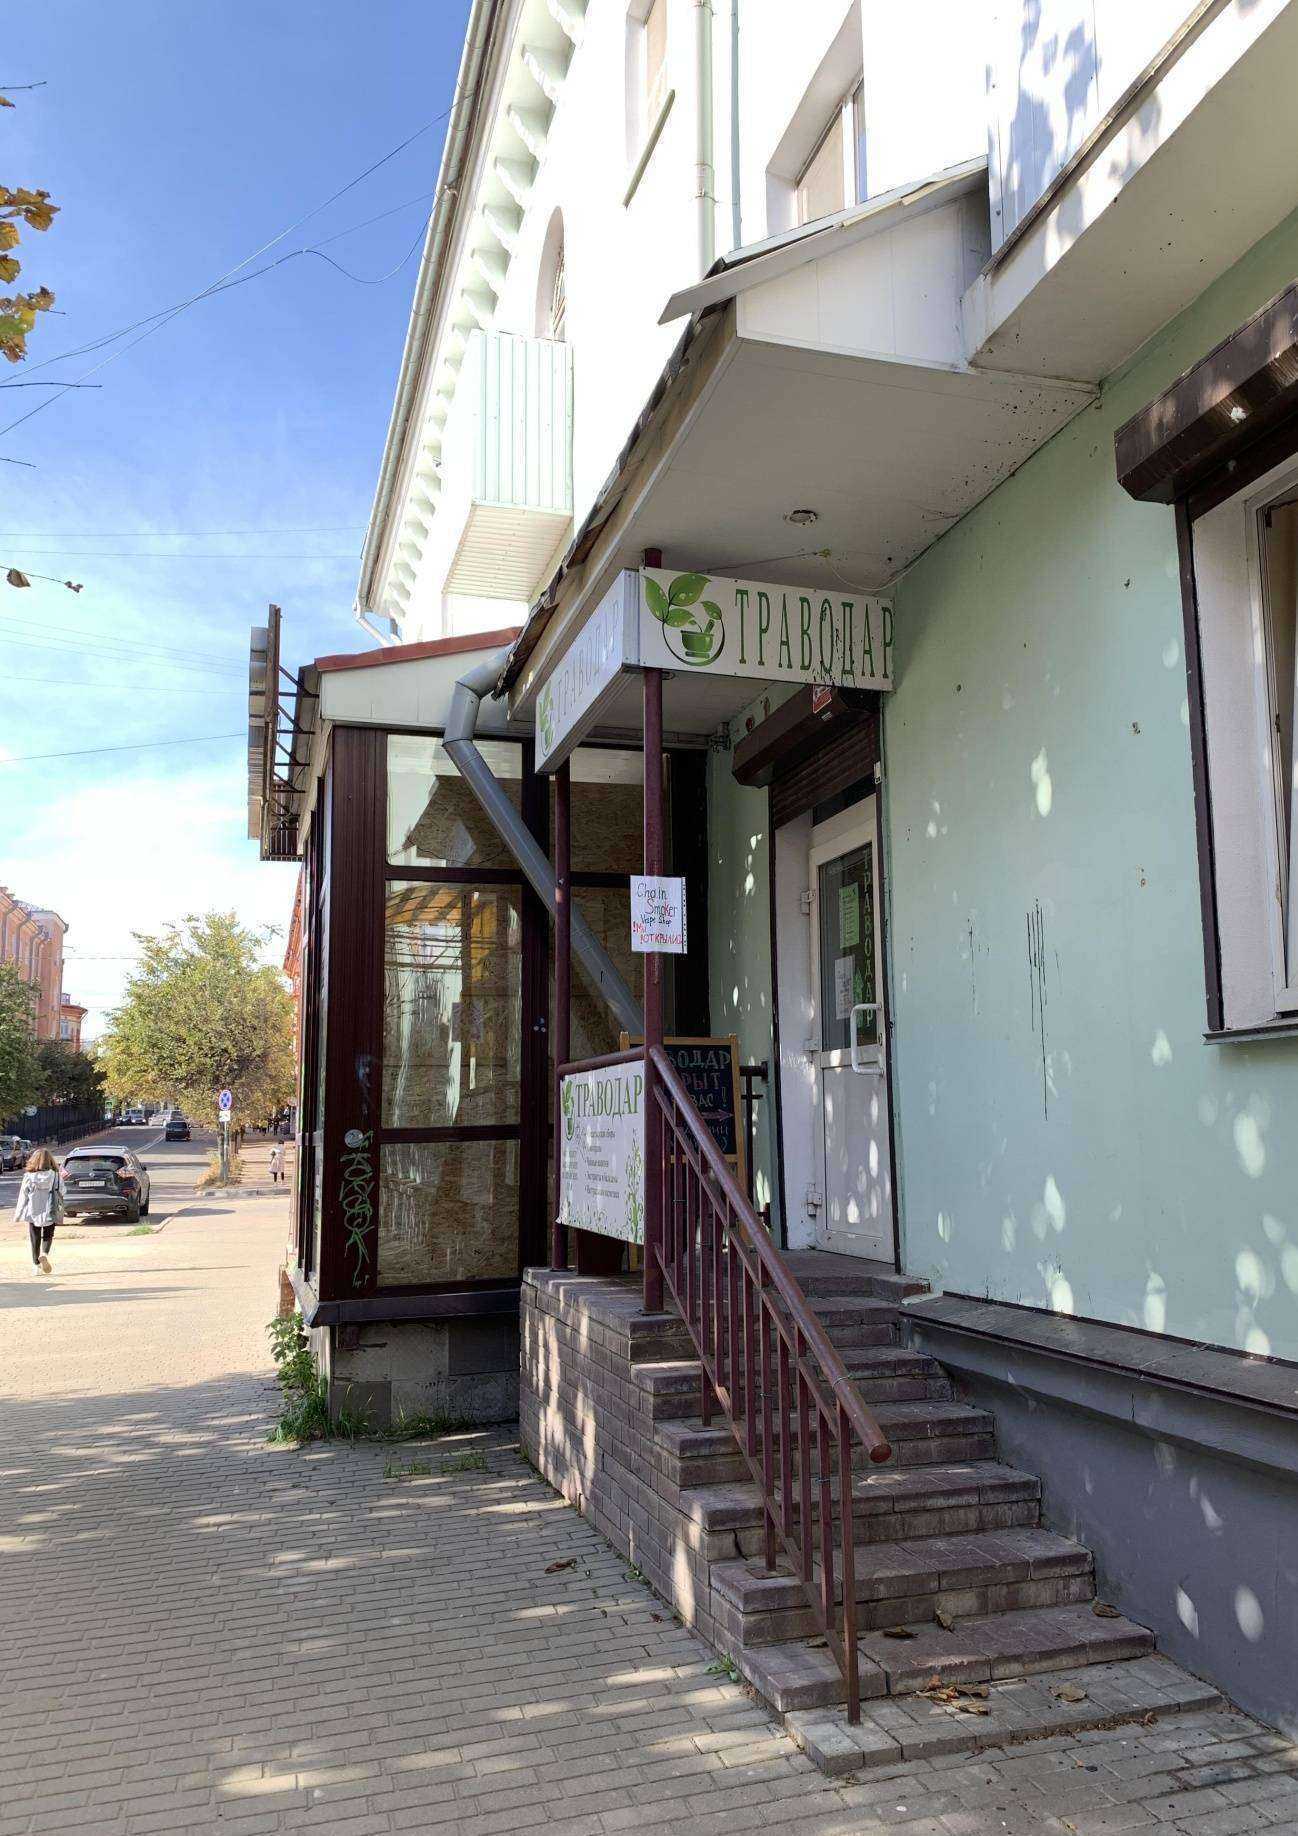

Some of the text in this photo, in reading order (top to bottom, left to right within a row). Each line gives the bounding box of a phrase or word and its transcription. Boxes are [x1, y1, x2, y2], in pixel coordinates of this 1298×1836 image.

[735, 588, 895, 688] ТРАВОДАР
[637, 883, 667, 900] Chain
[576, 1074, 643, 1125] ТРАВОДАР
